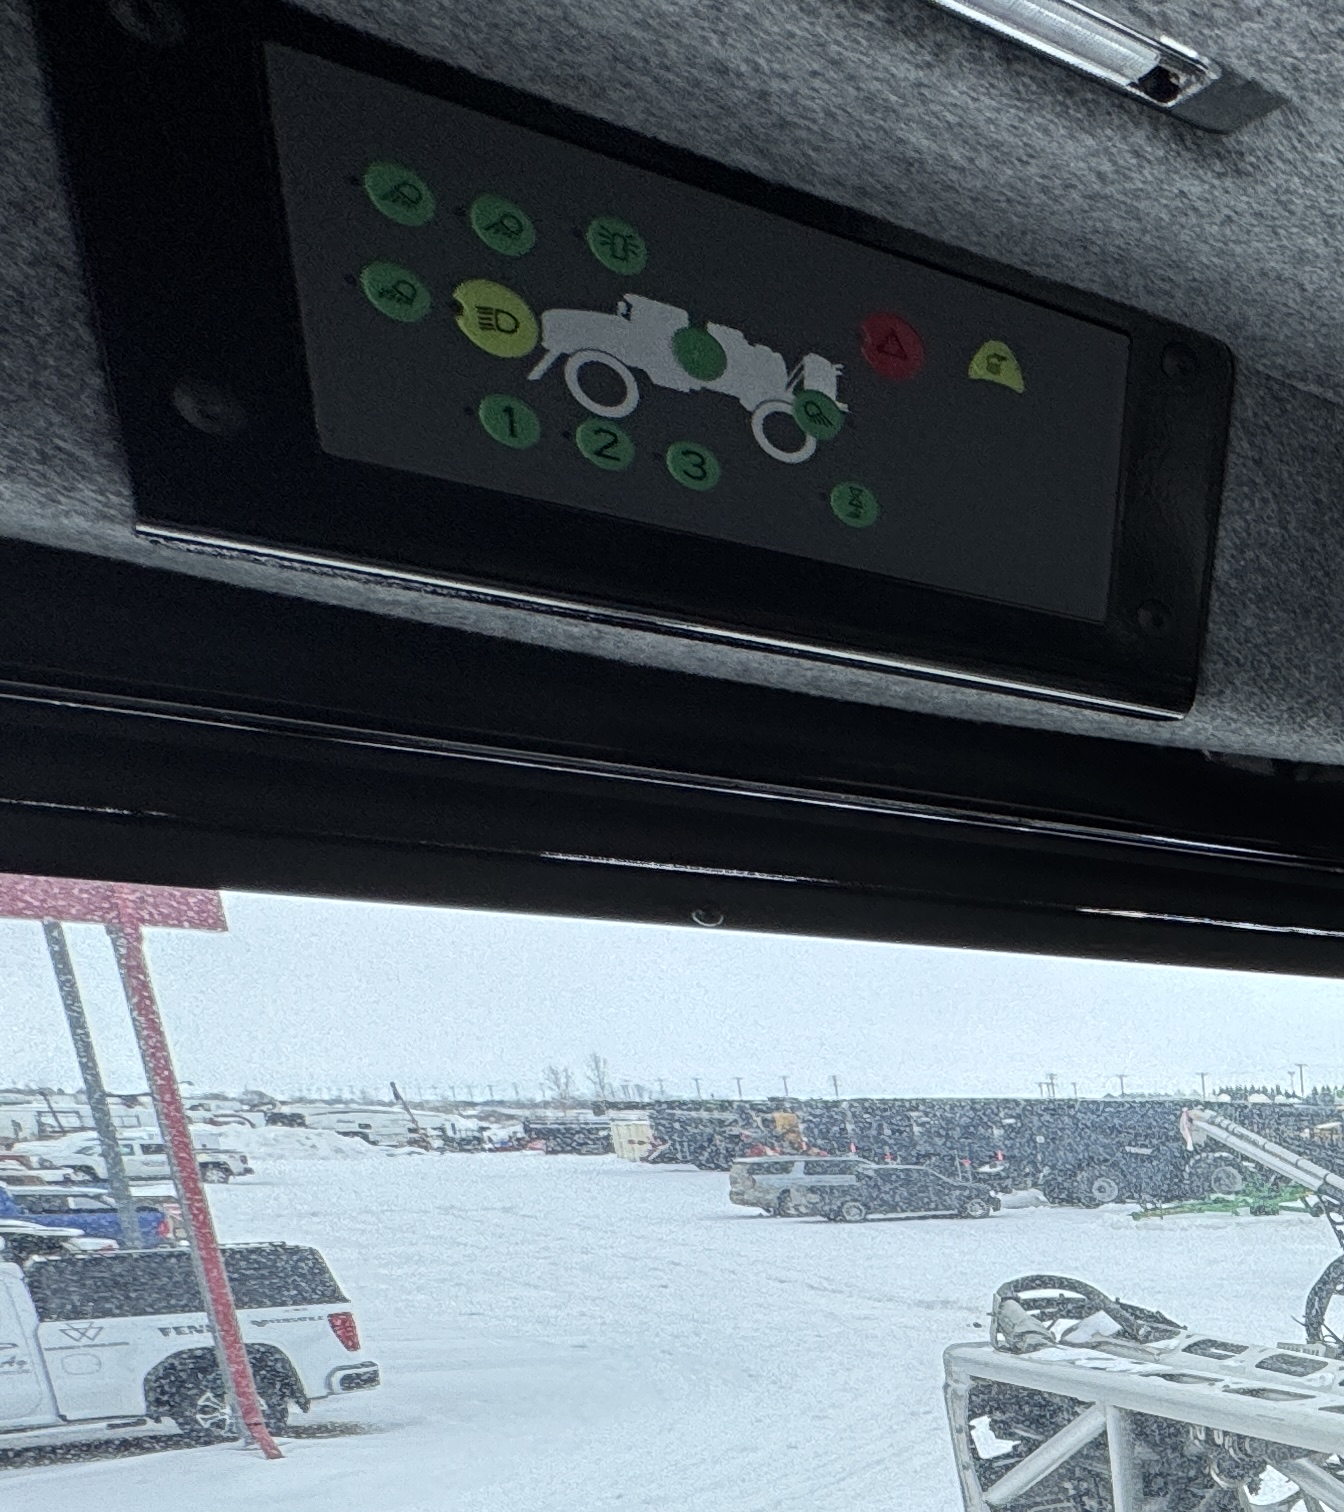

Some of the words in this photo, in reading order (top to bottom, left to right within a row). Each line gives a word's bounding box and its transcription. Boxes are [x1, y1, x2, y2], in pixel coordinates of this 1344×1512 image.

[503, 405, 518, 439] 1
[593, 427, 621, 462] 2
[680, 449, 707, 481] 3
